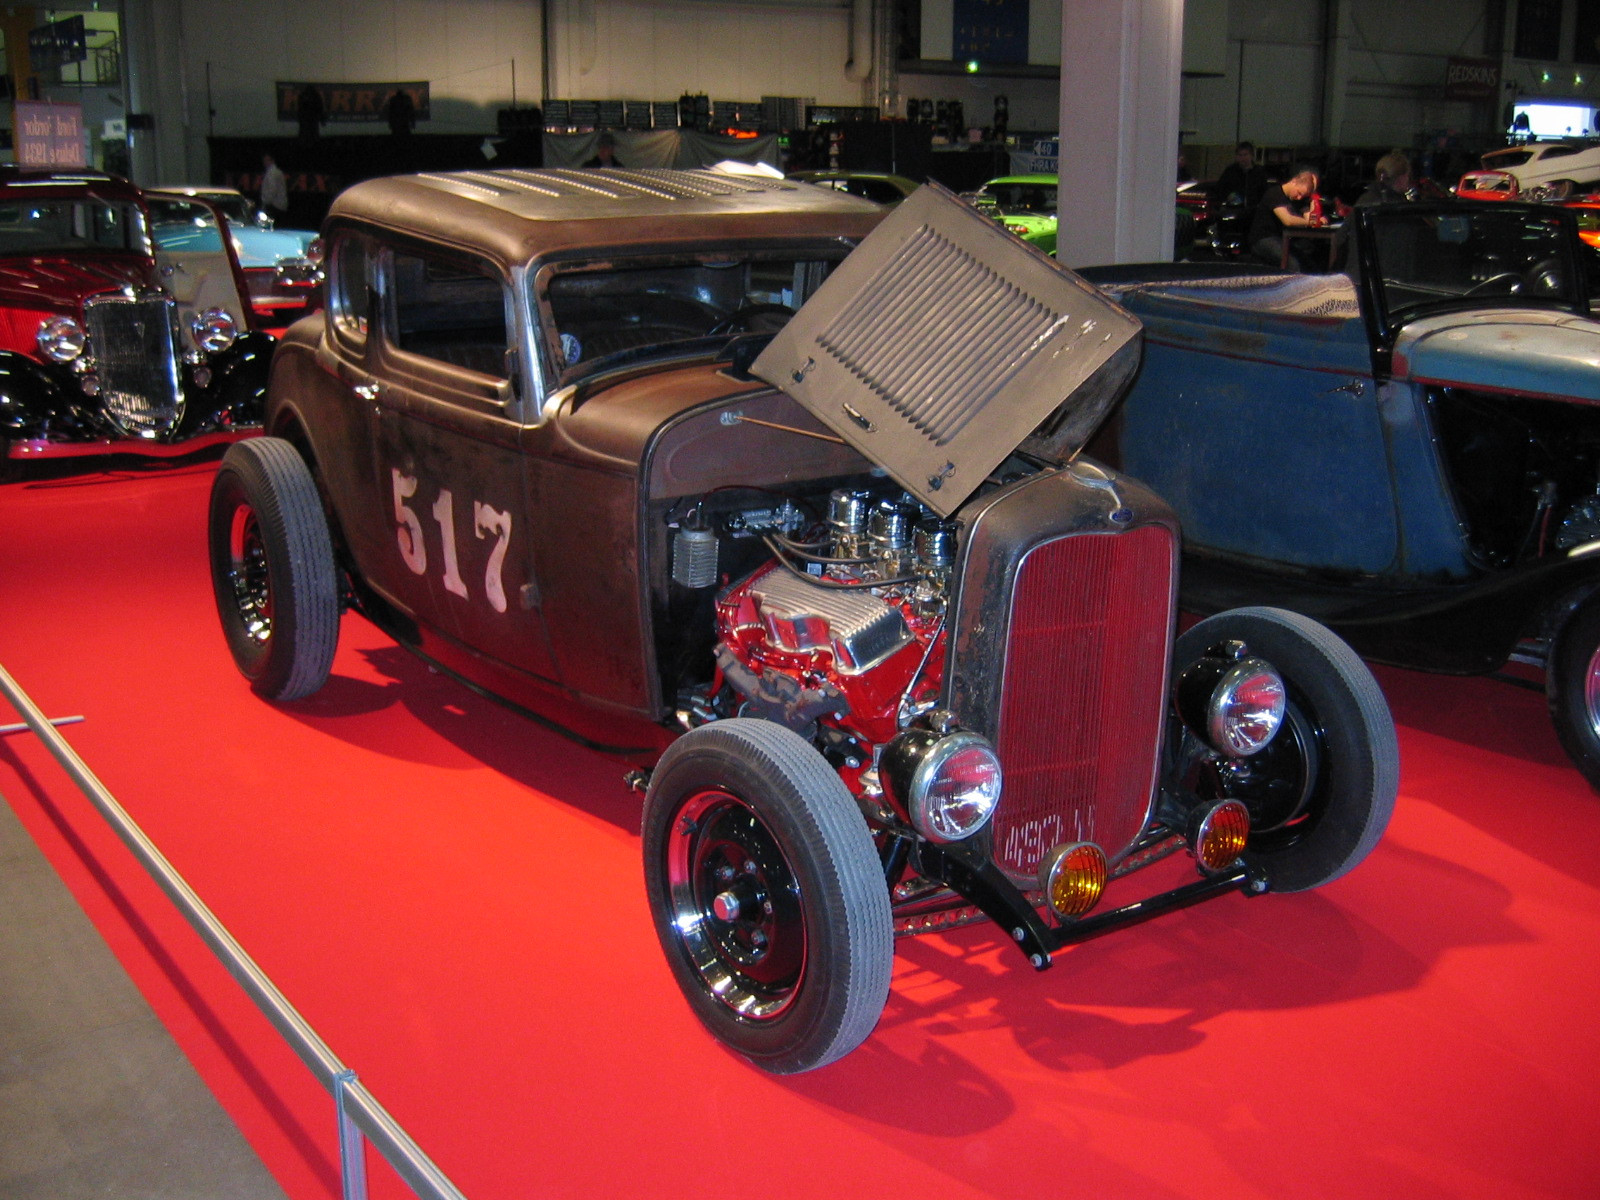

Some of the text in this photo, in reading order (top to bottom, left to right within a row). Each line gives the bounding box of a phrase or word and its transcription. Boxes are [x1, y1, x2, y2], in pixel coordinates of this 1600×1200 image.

[1447, 65, 1497, 88] REDSKINS
[283, 88, 425, 113] HRRAX
[392, 467, 512, 613] 517
